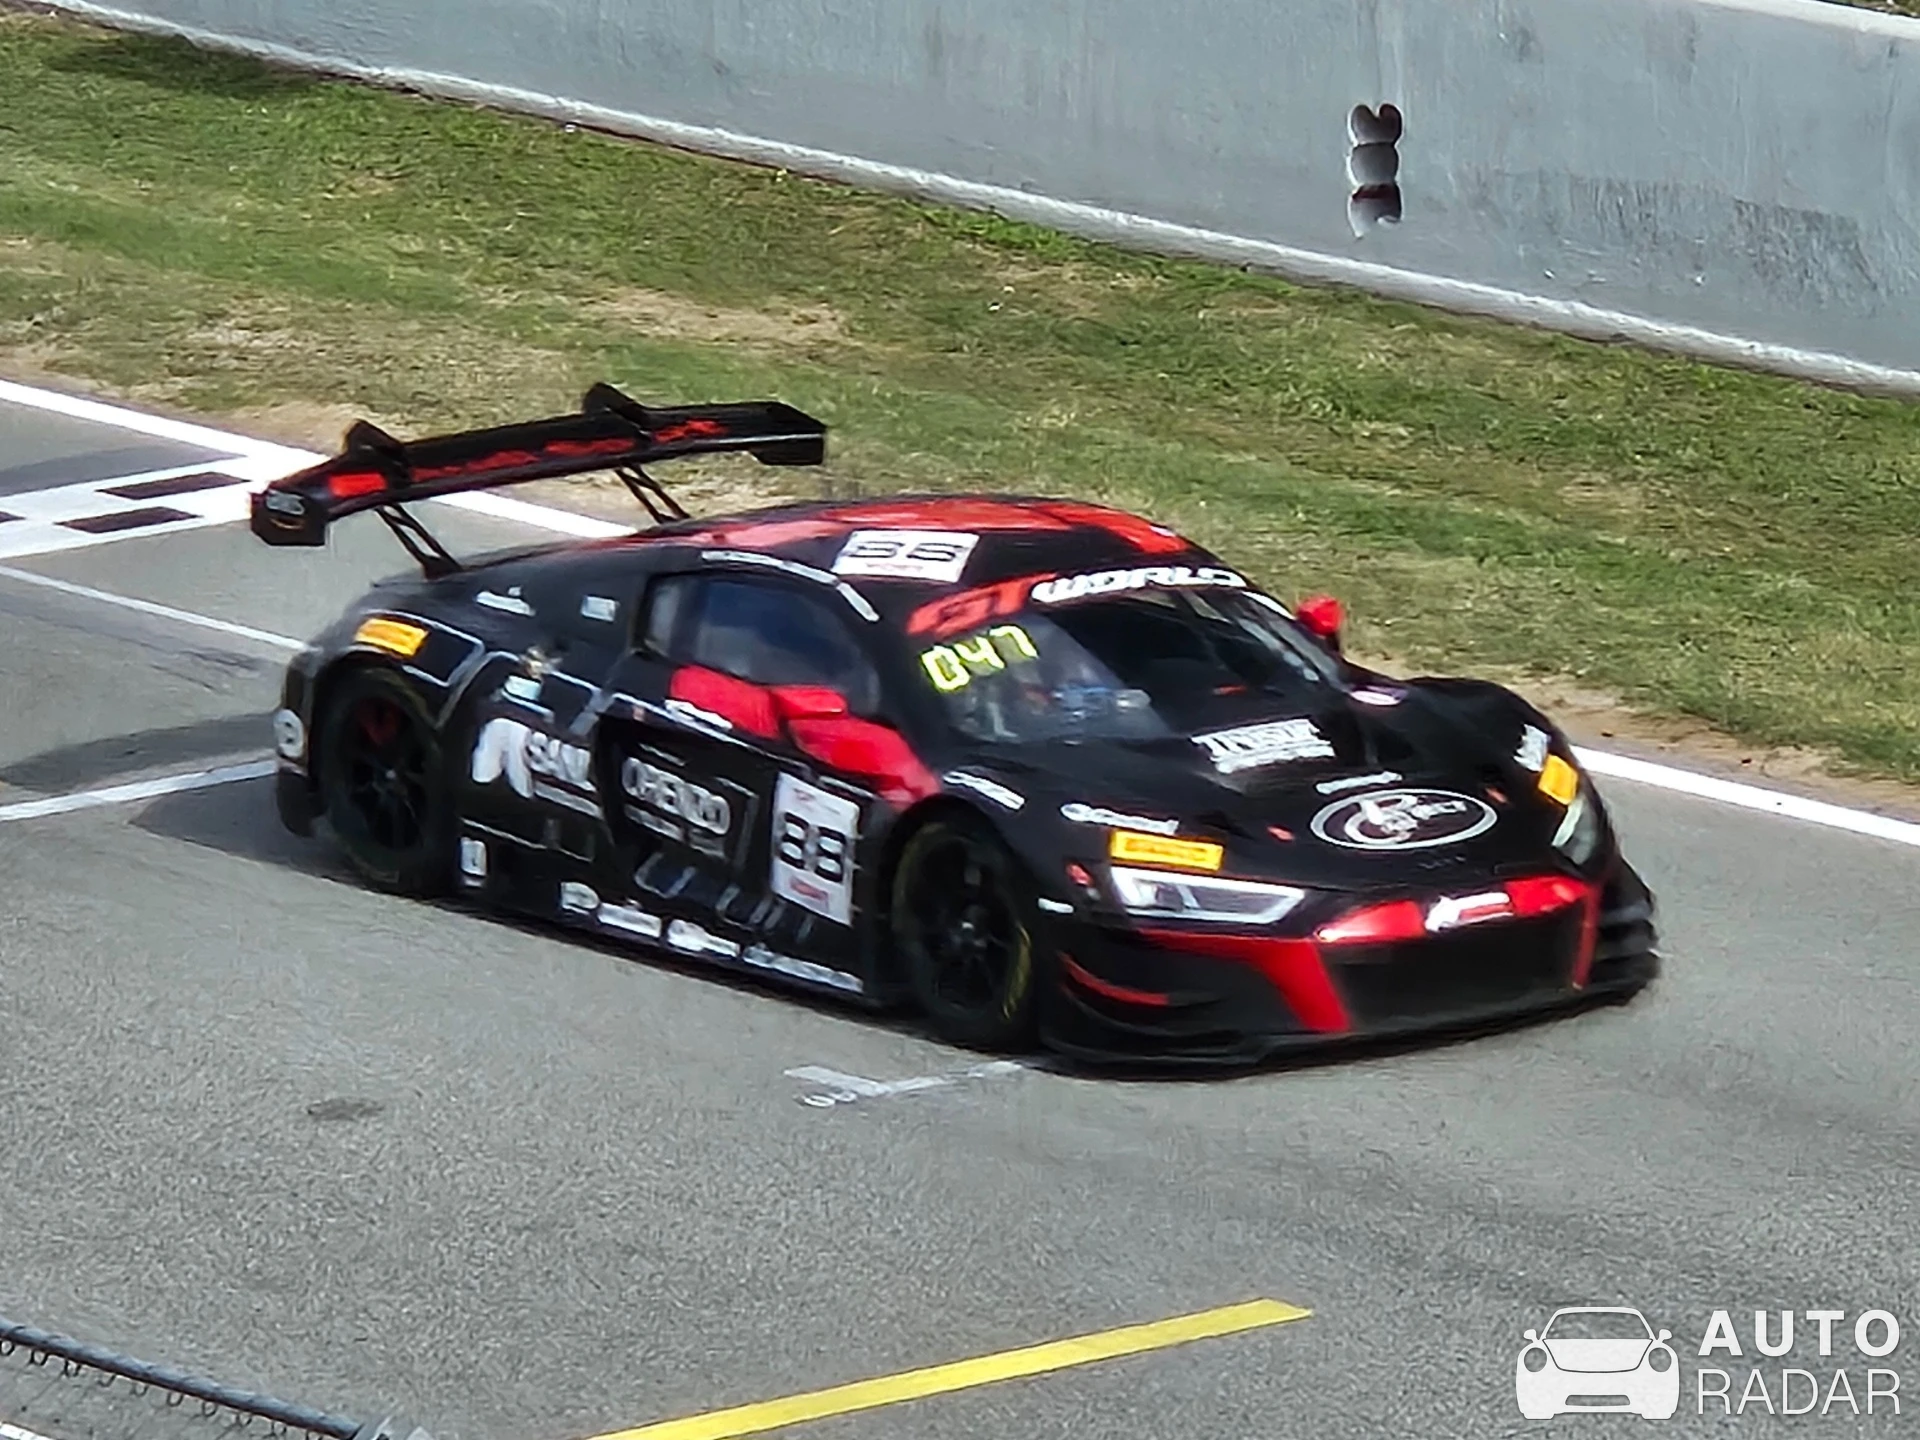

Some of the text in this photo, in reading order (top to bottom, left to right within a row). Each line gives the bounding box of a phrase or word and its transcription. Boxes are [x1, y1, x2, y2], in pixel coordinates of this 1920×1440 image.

[907, 567, 1247, 636] GT WORLD
[921, 624, 1039, 693] 047
